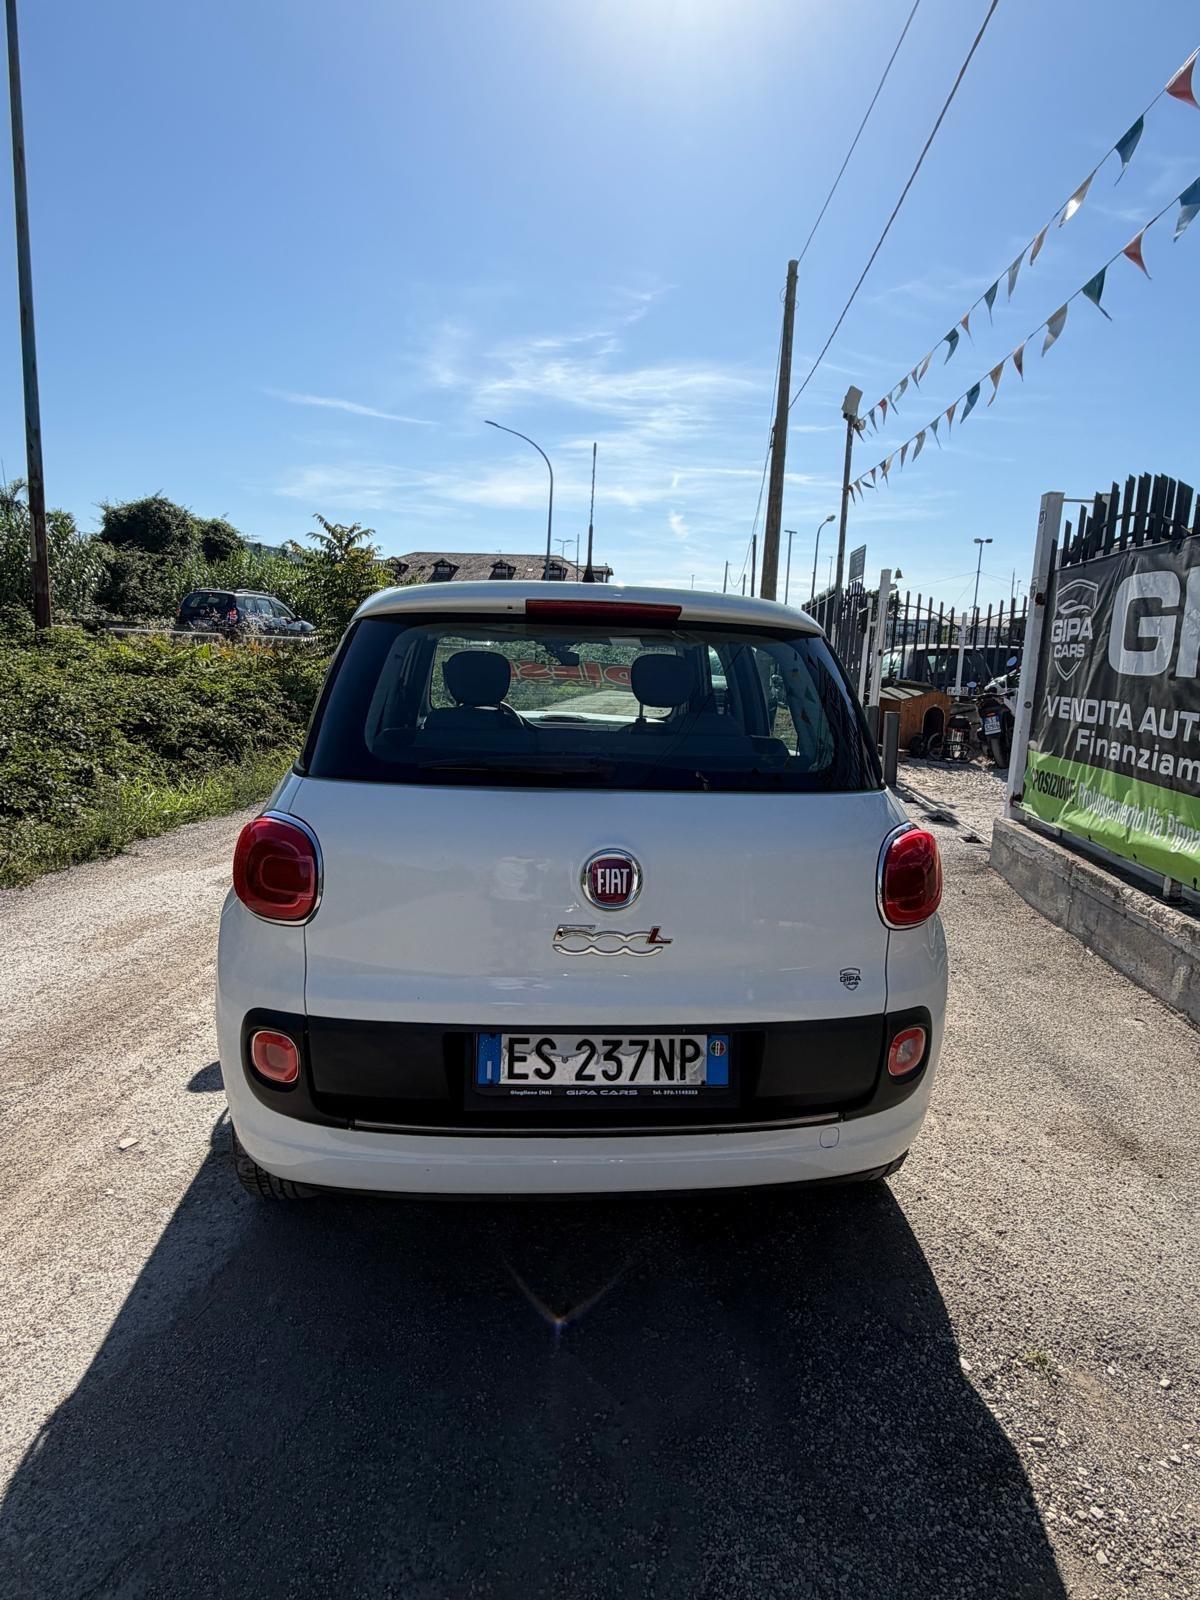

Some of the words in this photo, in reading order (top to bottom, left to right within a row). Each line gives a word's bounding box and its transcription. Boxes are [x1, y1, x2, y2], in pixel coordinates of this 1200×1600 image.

[1051, 616, 1094, 643] GIPA
[1053, 643, 1086, 658] CARS
[1047, 695, 1134, 731] VENDITA
[1138, 706, 1200, 742] AUT
[1075, 728, 1200, 784] Finanziam
[597, 868, 630, 894] FIAT
